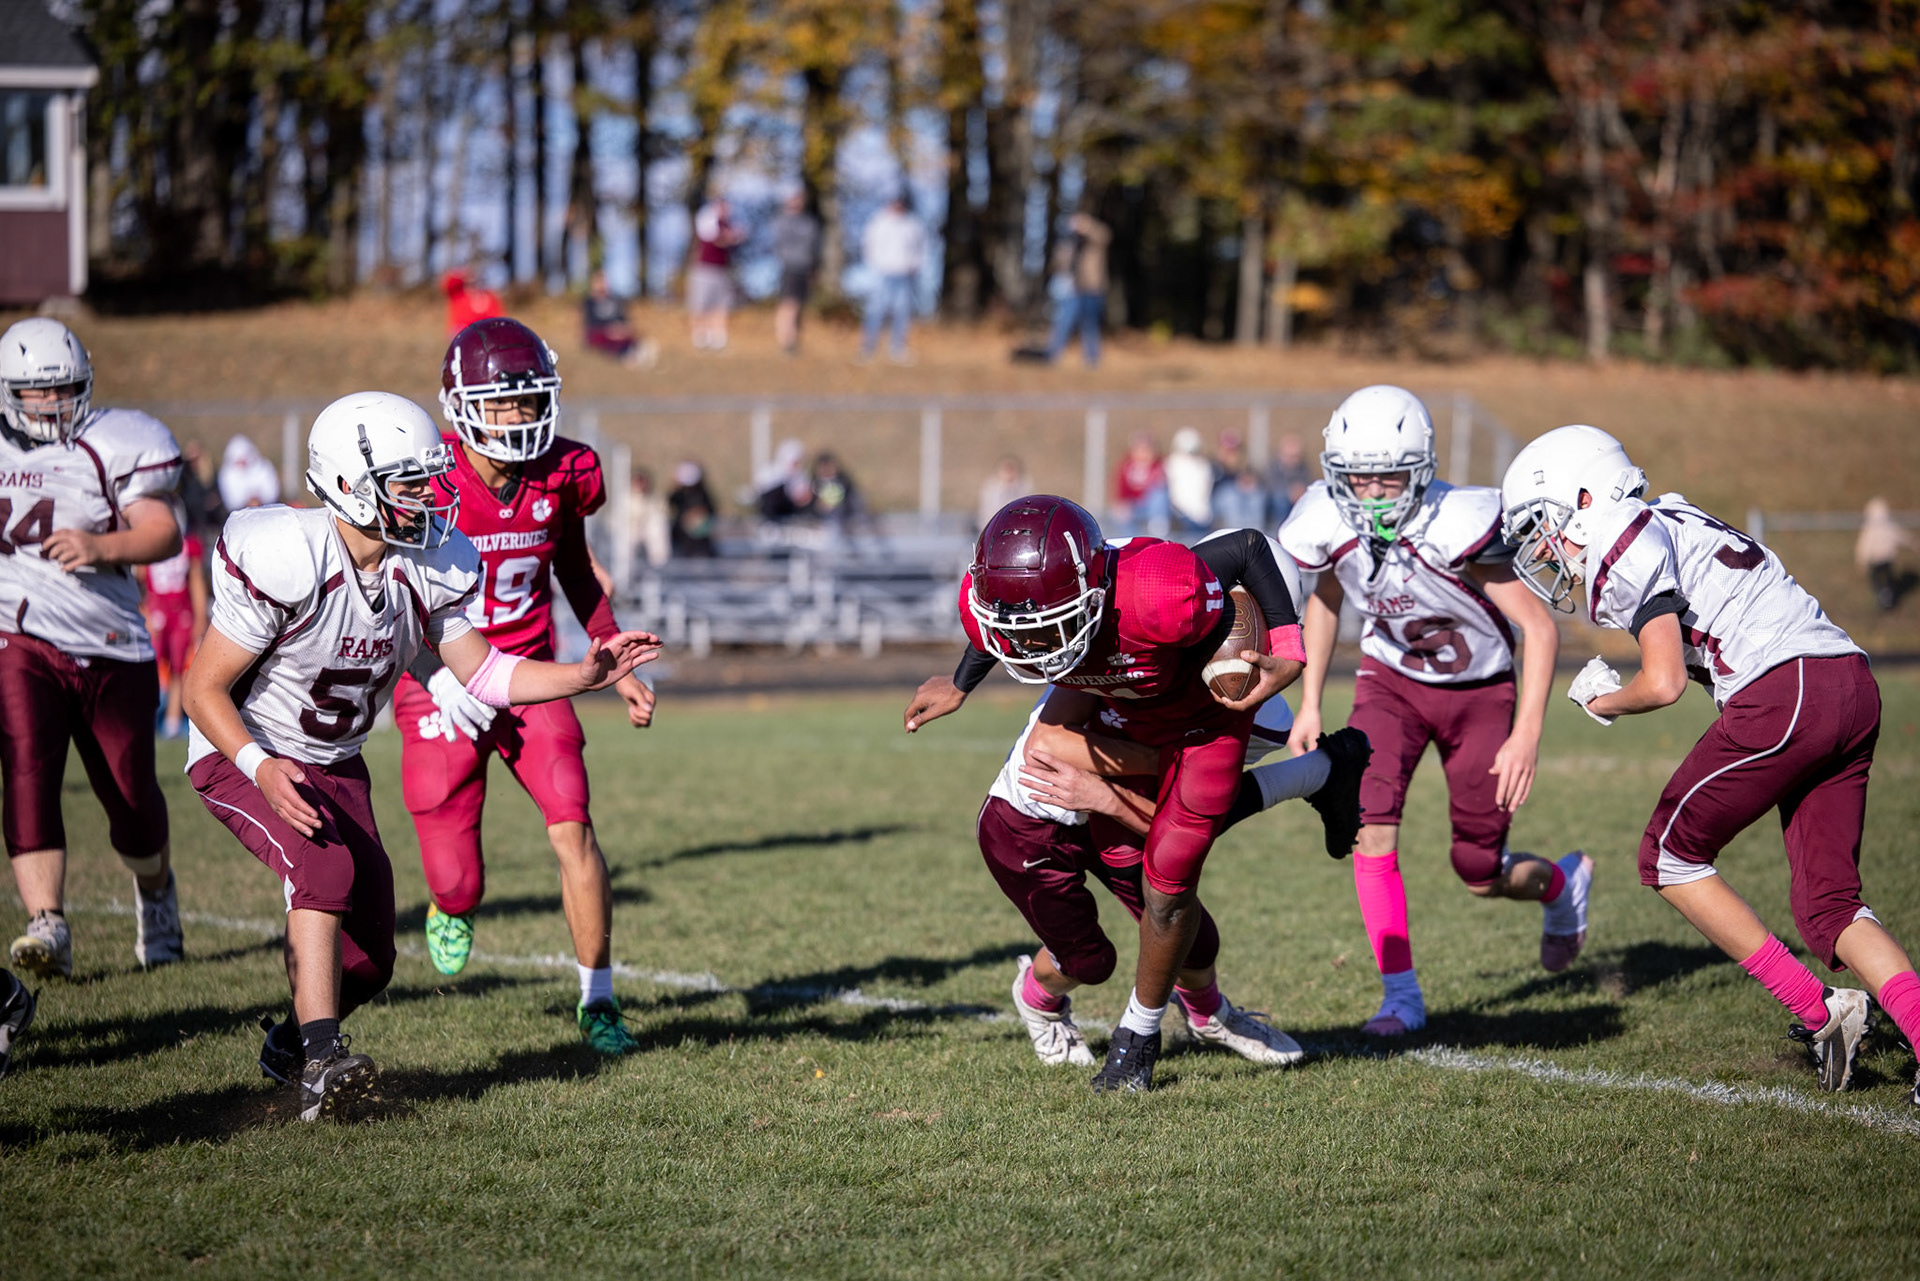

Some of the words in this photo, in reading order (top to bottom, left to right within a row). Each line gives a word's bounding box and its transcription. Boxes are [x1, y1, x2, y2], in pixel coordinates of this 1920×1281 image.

[467, 529, 548, 552] OLVERINES
[465, 555, 540, 628] 19
[338, 636, 395, 658] RAMS
